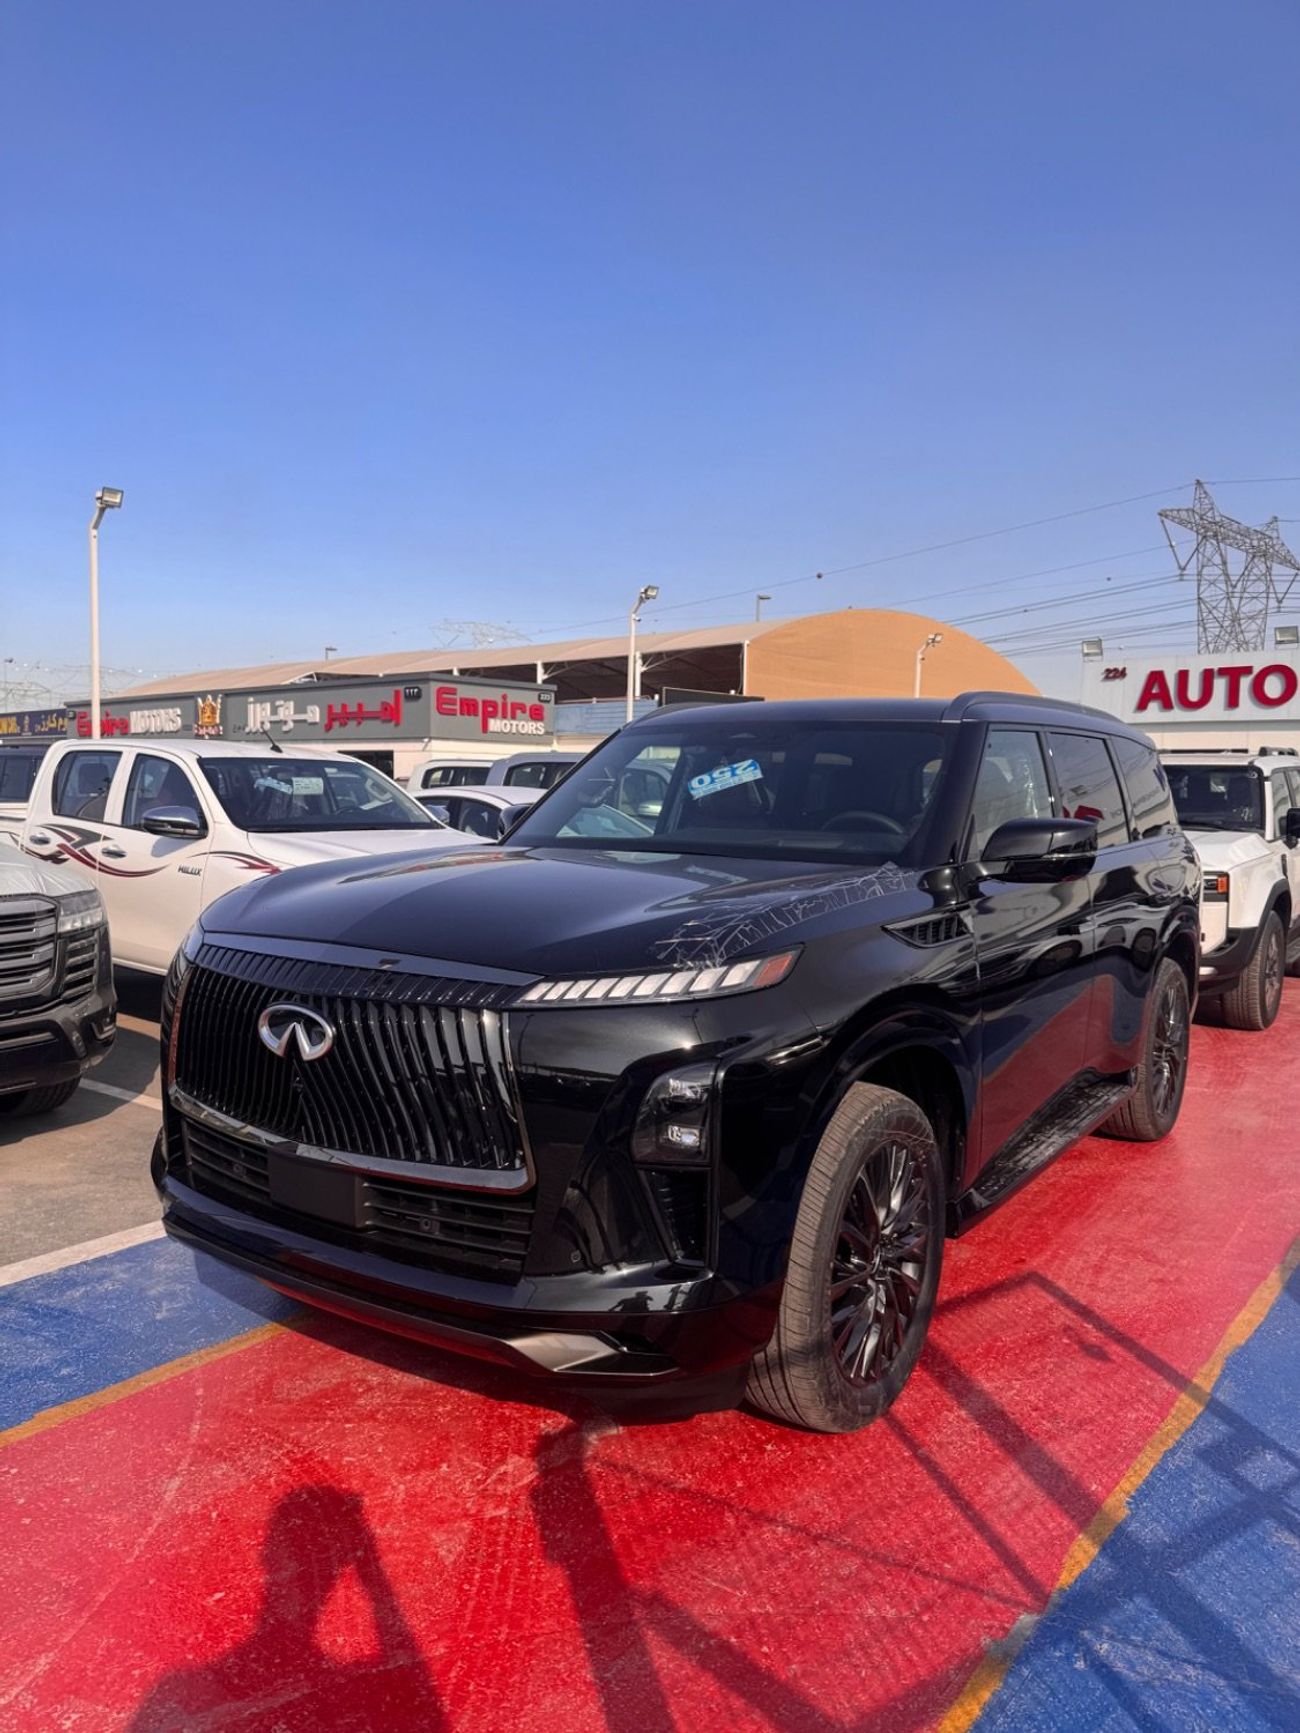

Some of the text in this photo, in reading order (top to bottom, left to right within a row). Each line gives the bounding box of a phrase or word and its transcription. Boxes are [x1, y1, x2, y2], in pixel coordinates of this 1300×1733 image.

[1136, 664, 1299, 711] AUTO
[129, 707, 182, 734] MOTORS
[436, 686, 545, 734] Empire
[488, 718, 545, 736] MOTORS
